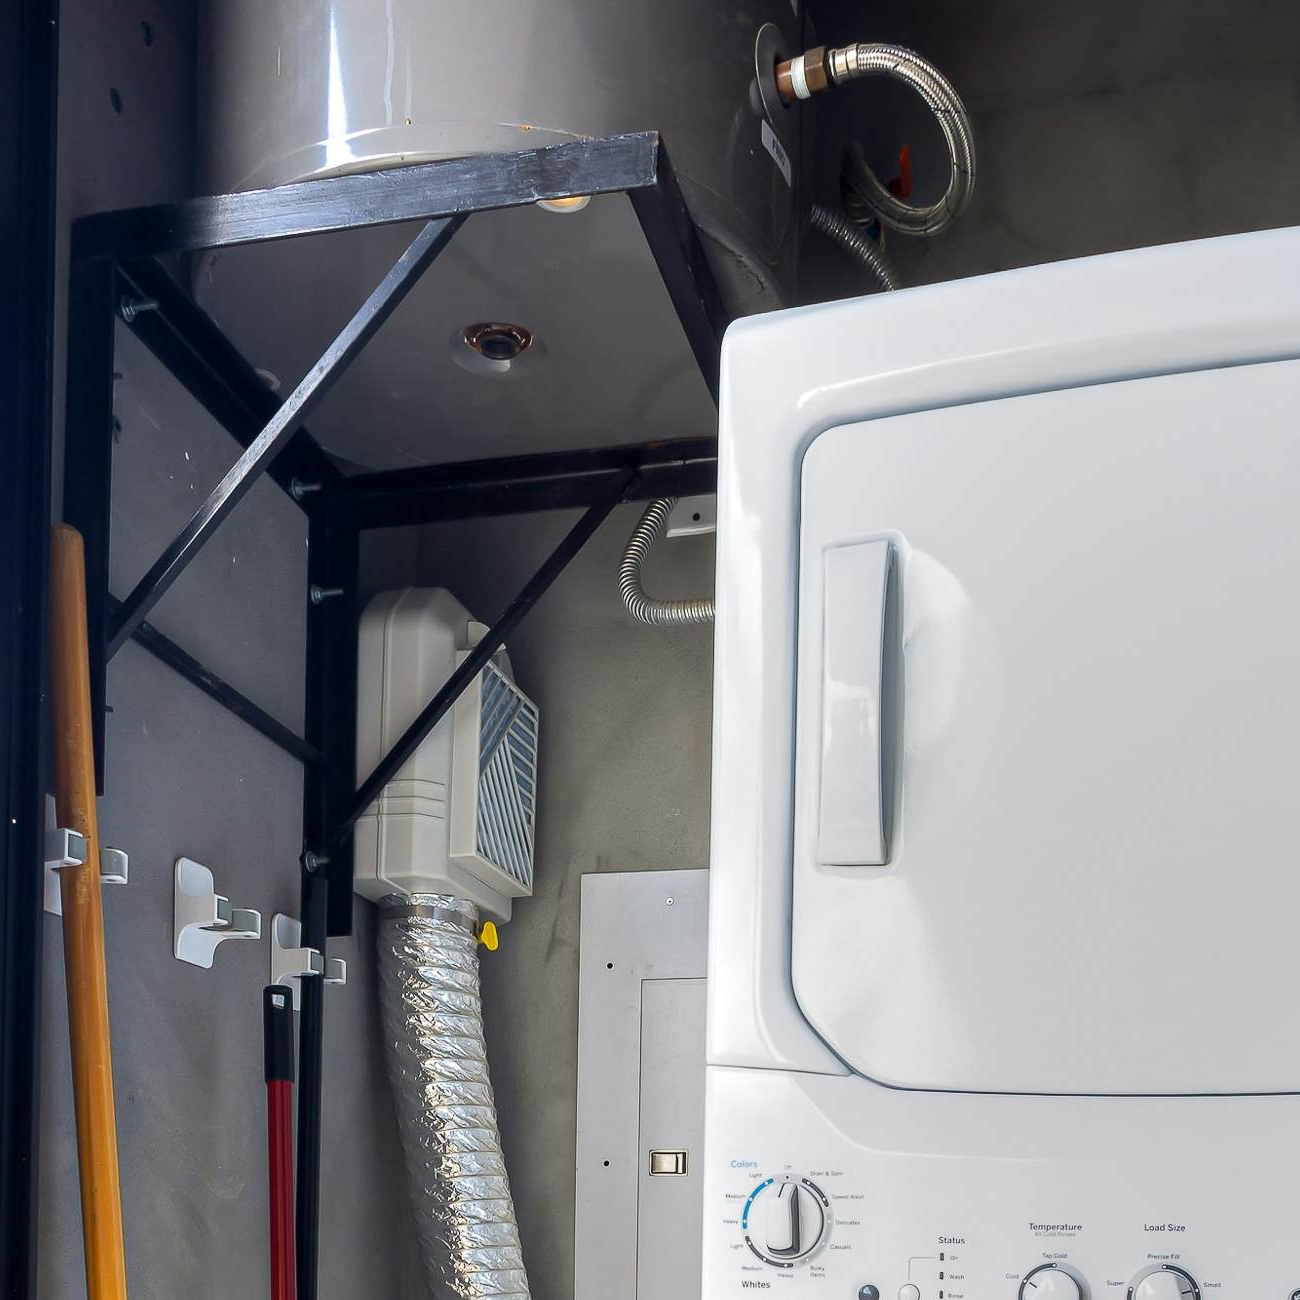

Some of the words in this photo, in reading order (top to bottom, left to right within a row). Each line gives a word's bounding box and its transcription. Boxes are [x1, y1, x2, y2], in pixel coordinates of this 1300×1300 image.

[731, 1160, 758, 1168] Colors
[1029, 1223, 1083, 1231] Temperature
[938, 1236, 965, 1244] Status
[741, 1281, 771, 1289] Whites
